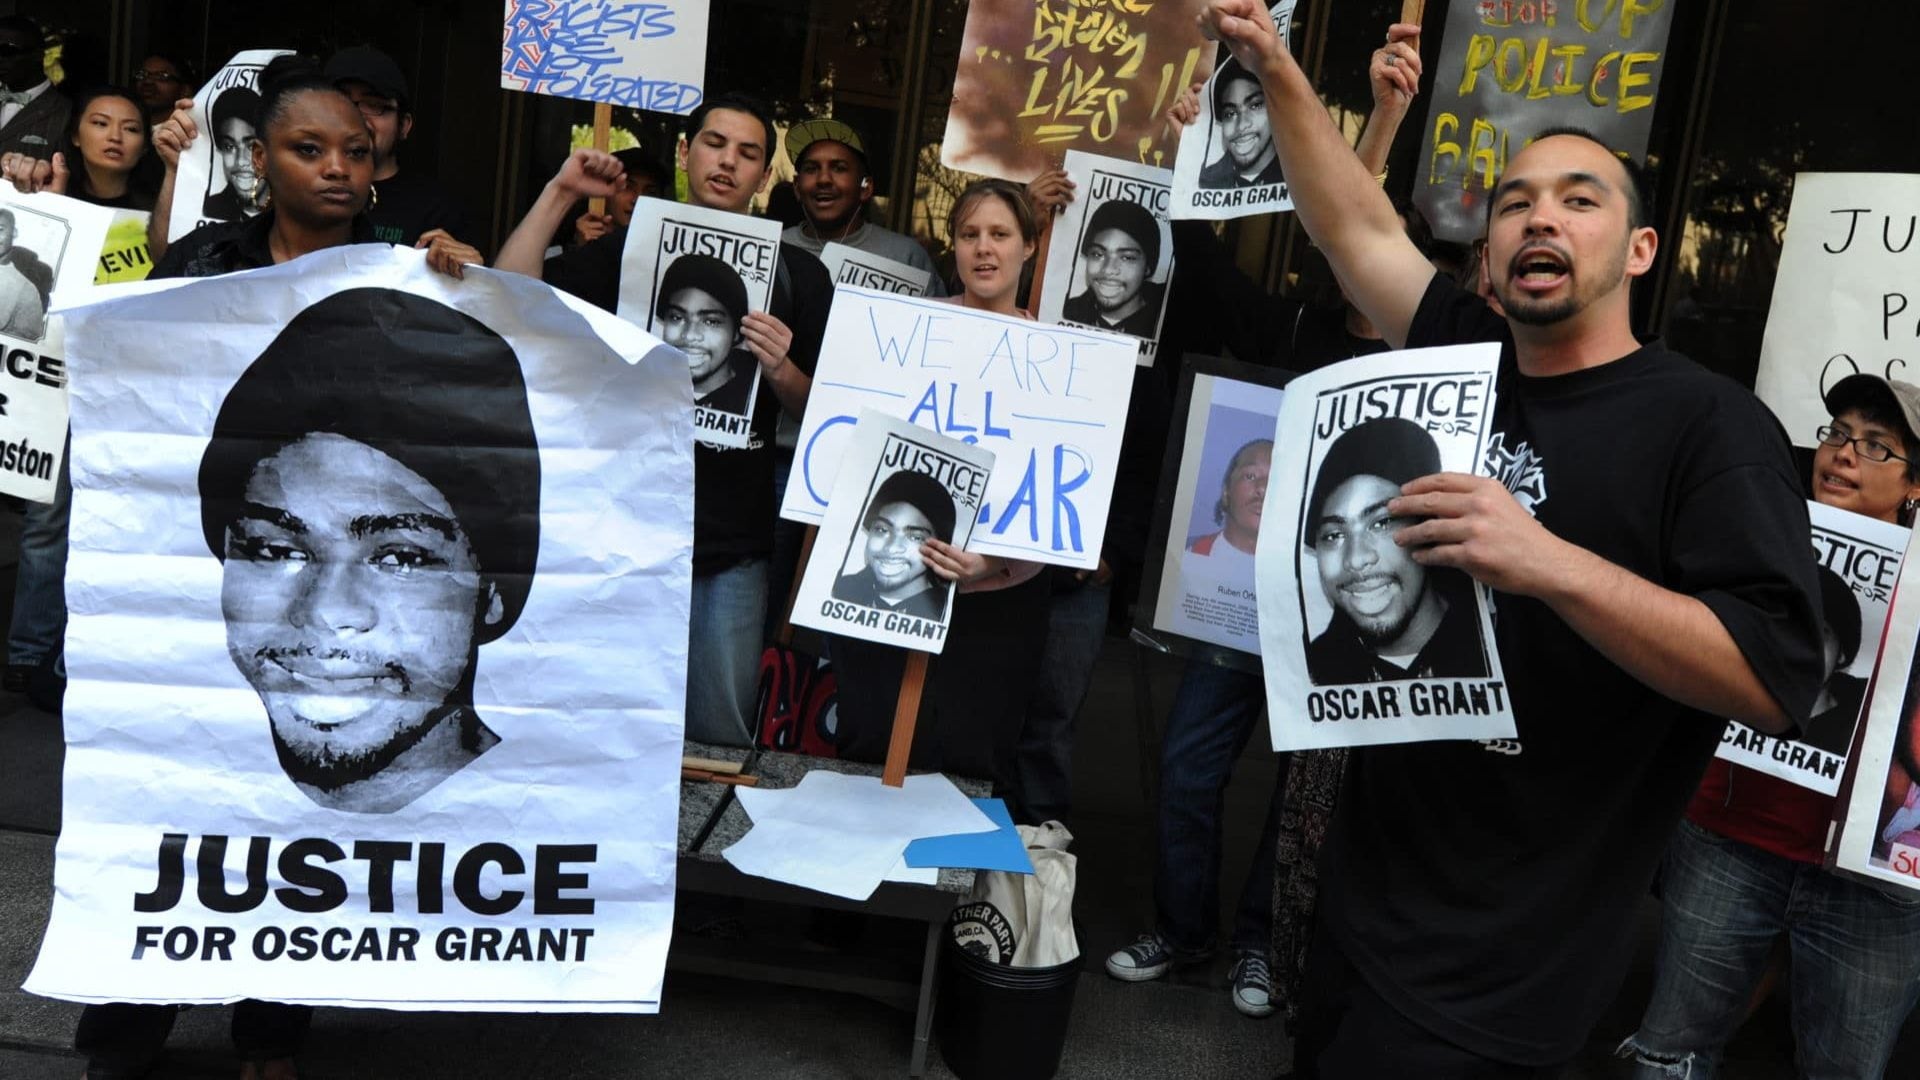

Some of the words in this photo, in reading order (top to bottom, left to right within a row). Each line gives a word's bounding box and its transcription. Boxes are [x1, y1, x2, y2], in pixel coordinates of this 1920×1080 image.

[508, 0, 676, 40] RACISTS
[216, 69, 259, 91] JUST
[512, 68, 702, 113] TOLERATED
[1459, 34, 1661, 114] POLICE
[1017, 55, 1128, 142] LIVES
[1093, 176, 1171, 212] JUSTIC
[1191, 190, 1243, 207] OSCAR
[1247, 185, 1289, 204] GRAN
[663, 226, 772, 272] JUSTICE
[738, 267, 769, 285] FOR
[868, 305, 952, 368] WE
[979, 328, 1100, 402] ARE
[695, 407, 751, 436] GRANT
[908, 380, 1012, 440] ALL
[1317, 379, 1483, 440] JUSTICE
[1426, 419, 1478, 437] FOR
[885, 441, 985, 497] JUSTICE
[951, 489, 977, 510] FOR
[1811, 533, 1899, 591] STICE
[1218, 585, 1241, 598] Ruben
[1850, 580, 1890, 605] FOR
[820, 599, 881, 629] OSCAR
[884, 612, 947, 641] GRANT
[1307, 685, 1402, 723] OSCAR
[1408, 681, 1504, 717] GRANT
[1721, 722, 1767, 756] CAR
[1770, 739, 1847, 781] GRAN
[134, 832, 598, 916] JUSTICE
[131, 925, 237, 962] FOR
[251, 926, 421, 962] OSCAR
[434, 926, 595, 962] GRANT
[988, 914, 1013, 956] PARTY
